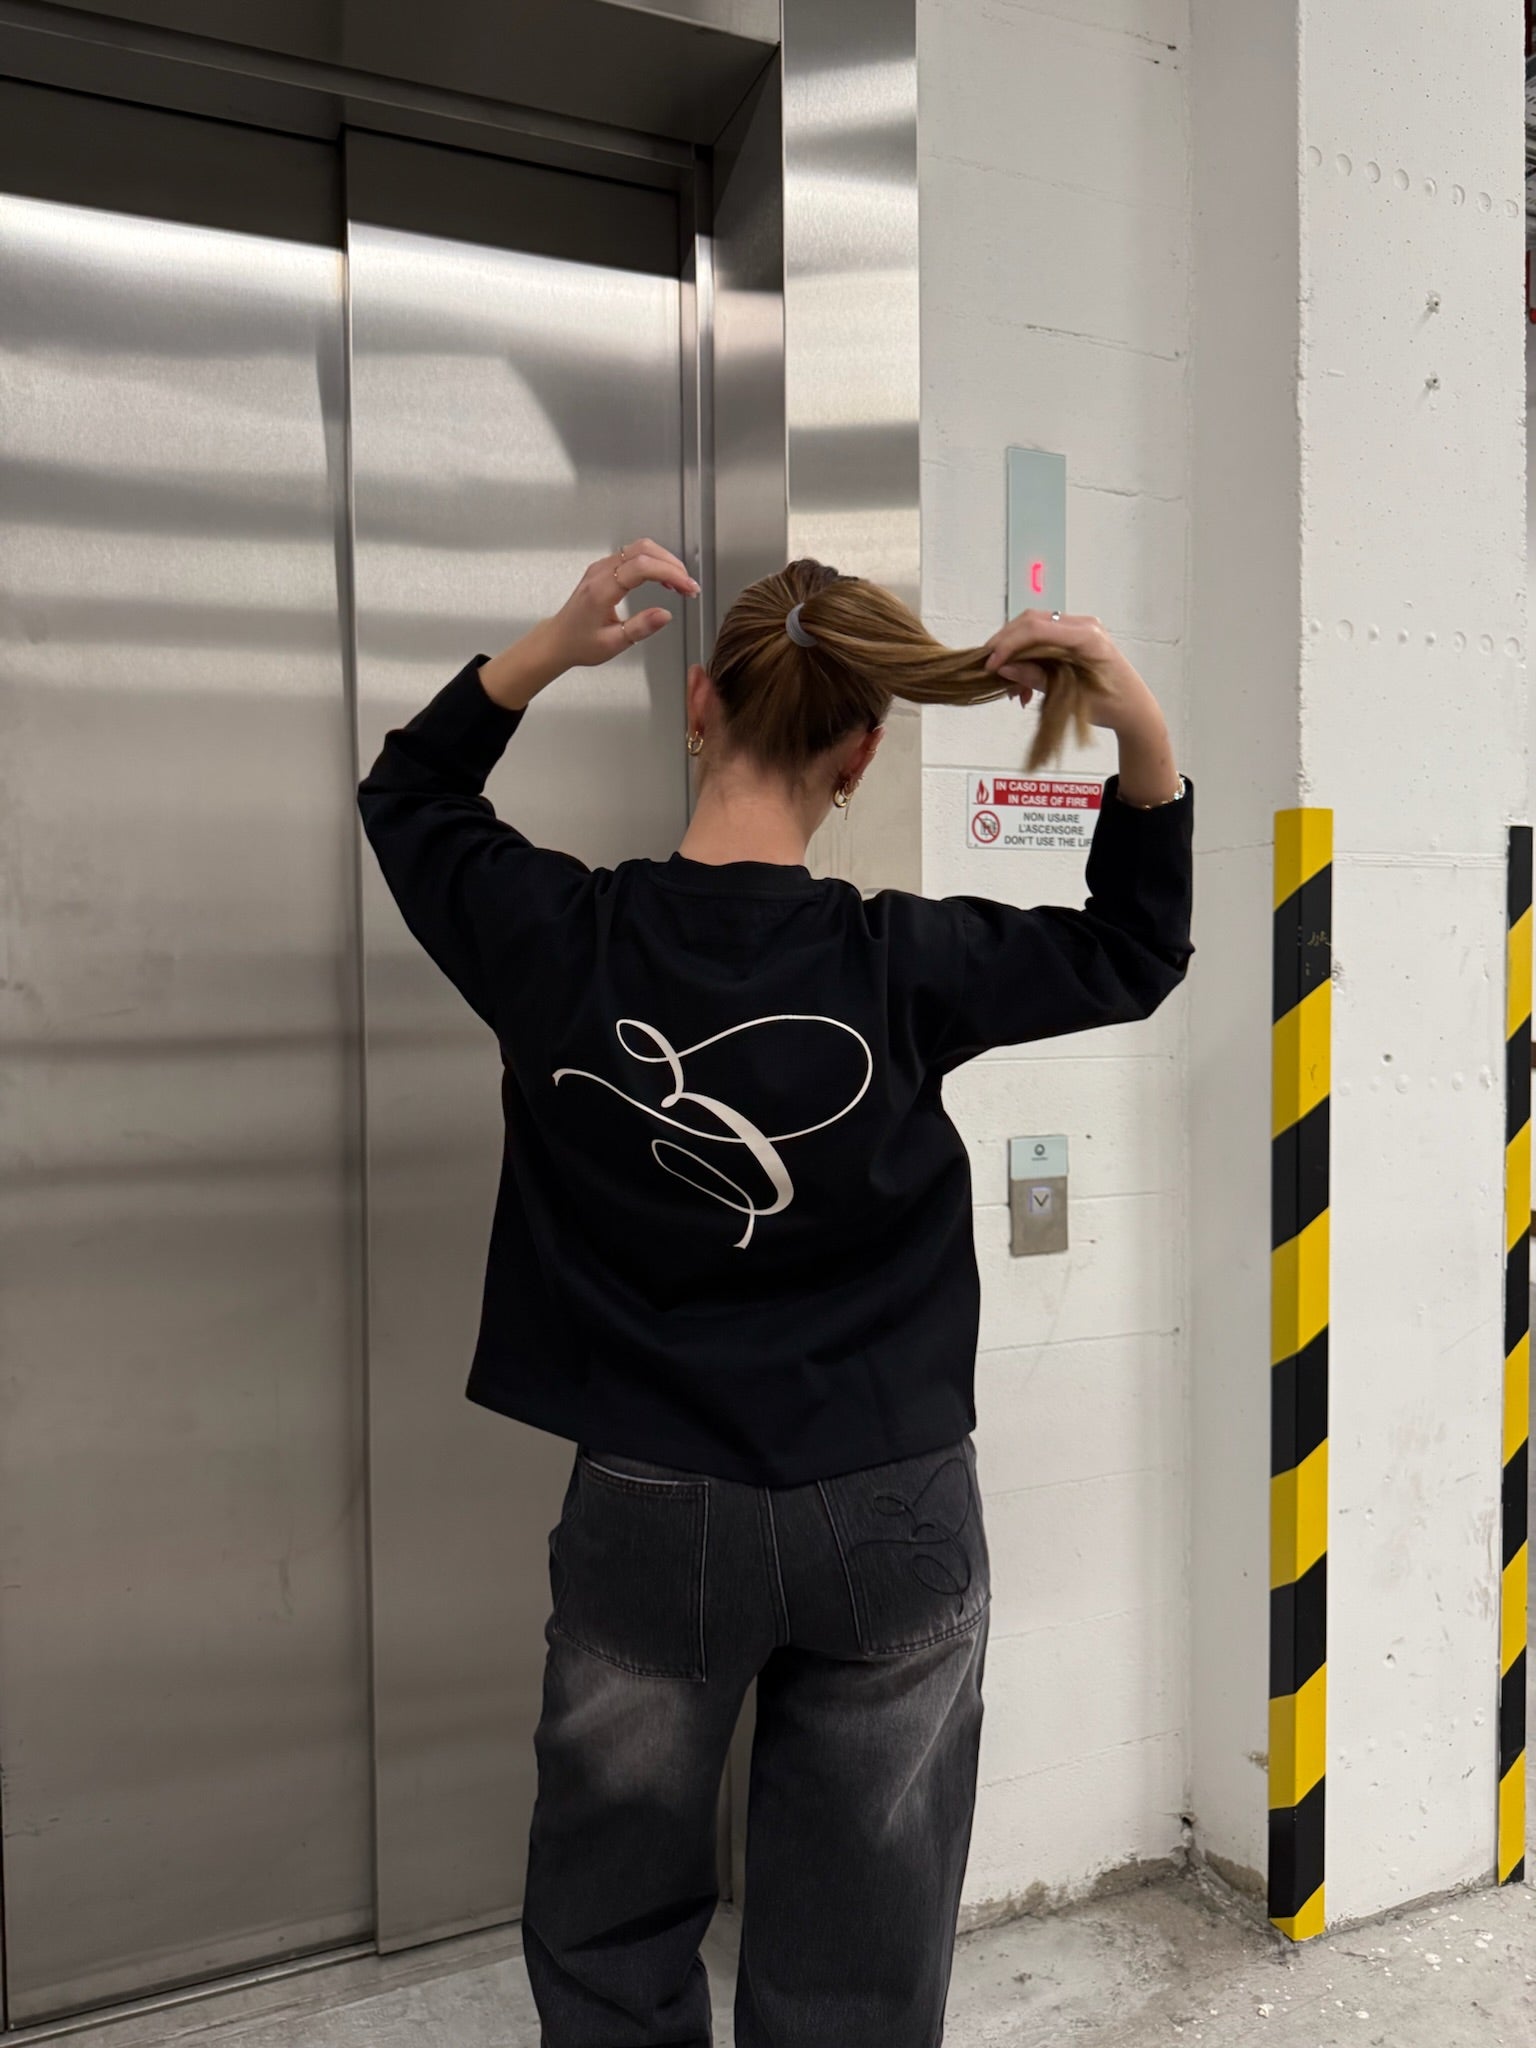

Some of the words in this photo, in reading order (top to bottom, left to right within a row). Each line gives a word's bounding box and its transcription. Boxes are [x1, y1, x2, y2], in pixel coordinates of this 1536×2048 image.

[995, 780, 1007, 791] IN
[1008, 781, 1037, 793] CASO
[1039, 783, 1051, 793] DI
[1052, 784, 1100, 796] INCENDIO
[1008, 794, 1019, 804] IN
[1021, 795, 1048, 806] CASE
[1050, 797, 1064, 807] OF
[1066, 797, 1088, 807] FIRE
[1023, 812, 1045, 822] NON
[1047, 813, 1079, 824] USARE
[1018, 824, 1084, 836] L'ASCENSORE
[1004, 835, 1033, 846] DON'T
[1036, 837, 1055, 846] USE
[1058, 838, 1076, 847] THE
[1078, 838, 1093, 848] LIF
